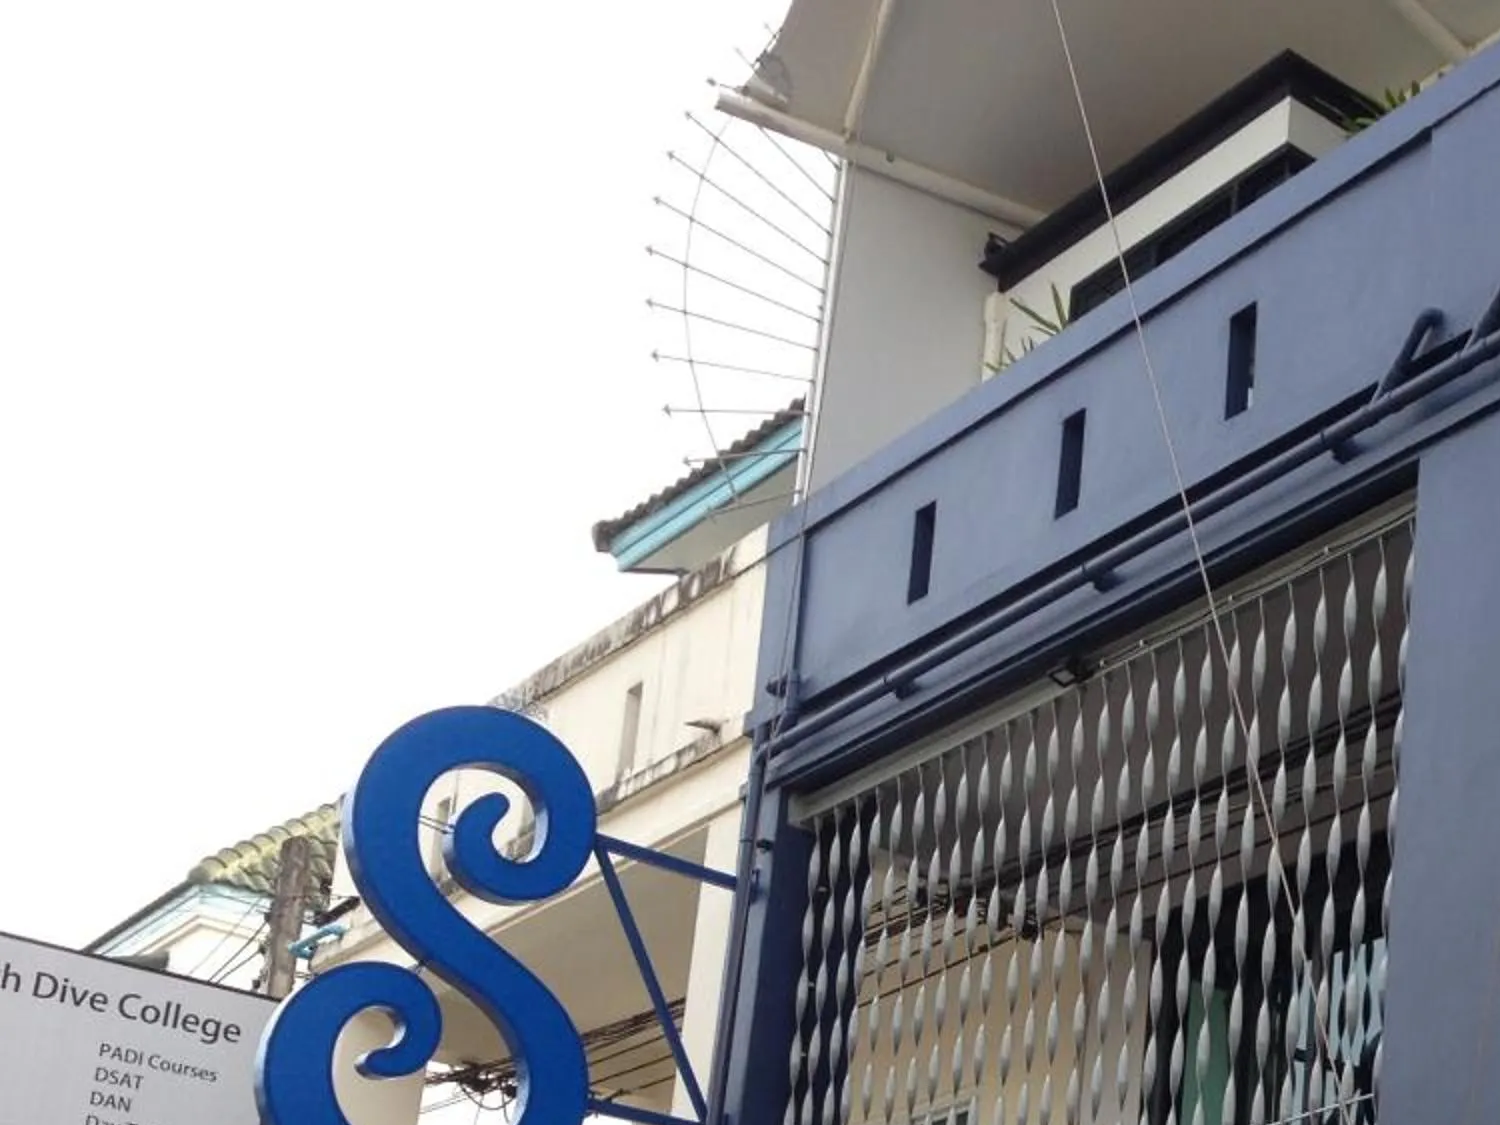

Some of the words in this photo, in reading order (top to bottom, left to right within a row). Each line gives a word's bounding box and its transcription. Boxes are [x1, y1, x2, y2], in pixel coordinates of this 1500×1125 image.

[32, 971, 108, 1013] Dive
[118, 992, 242, 1044] College
[94, 1066, 144, 1090] DSAT
[98, 1042, 144, 1067] PADI
[147, 1055, 218, 1082] Courses
[89, 1090, 132, 1113] DAN
